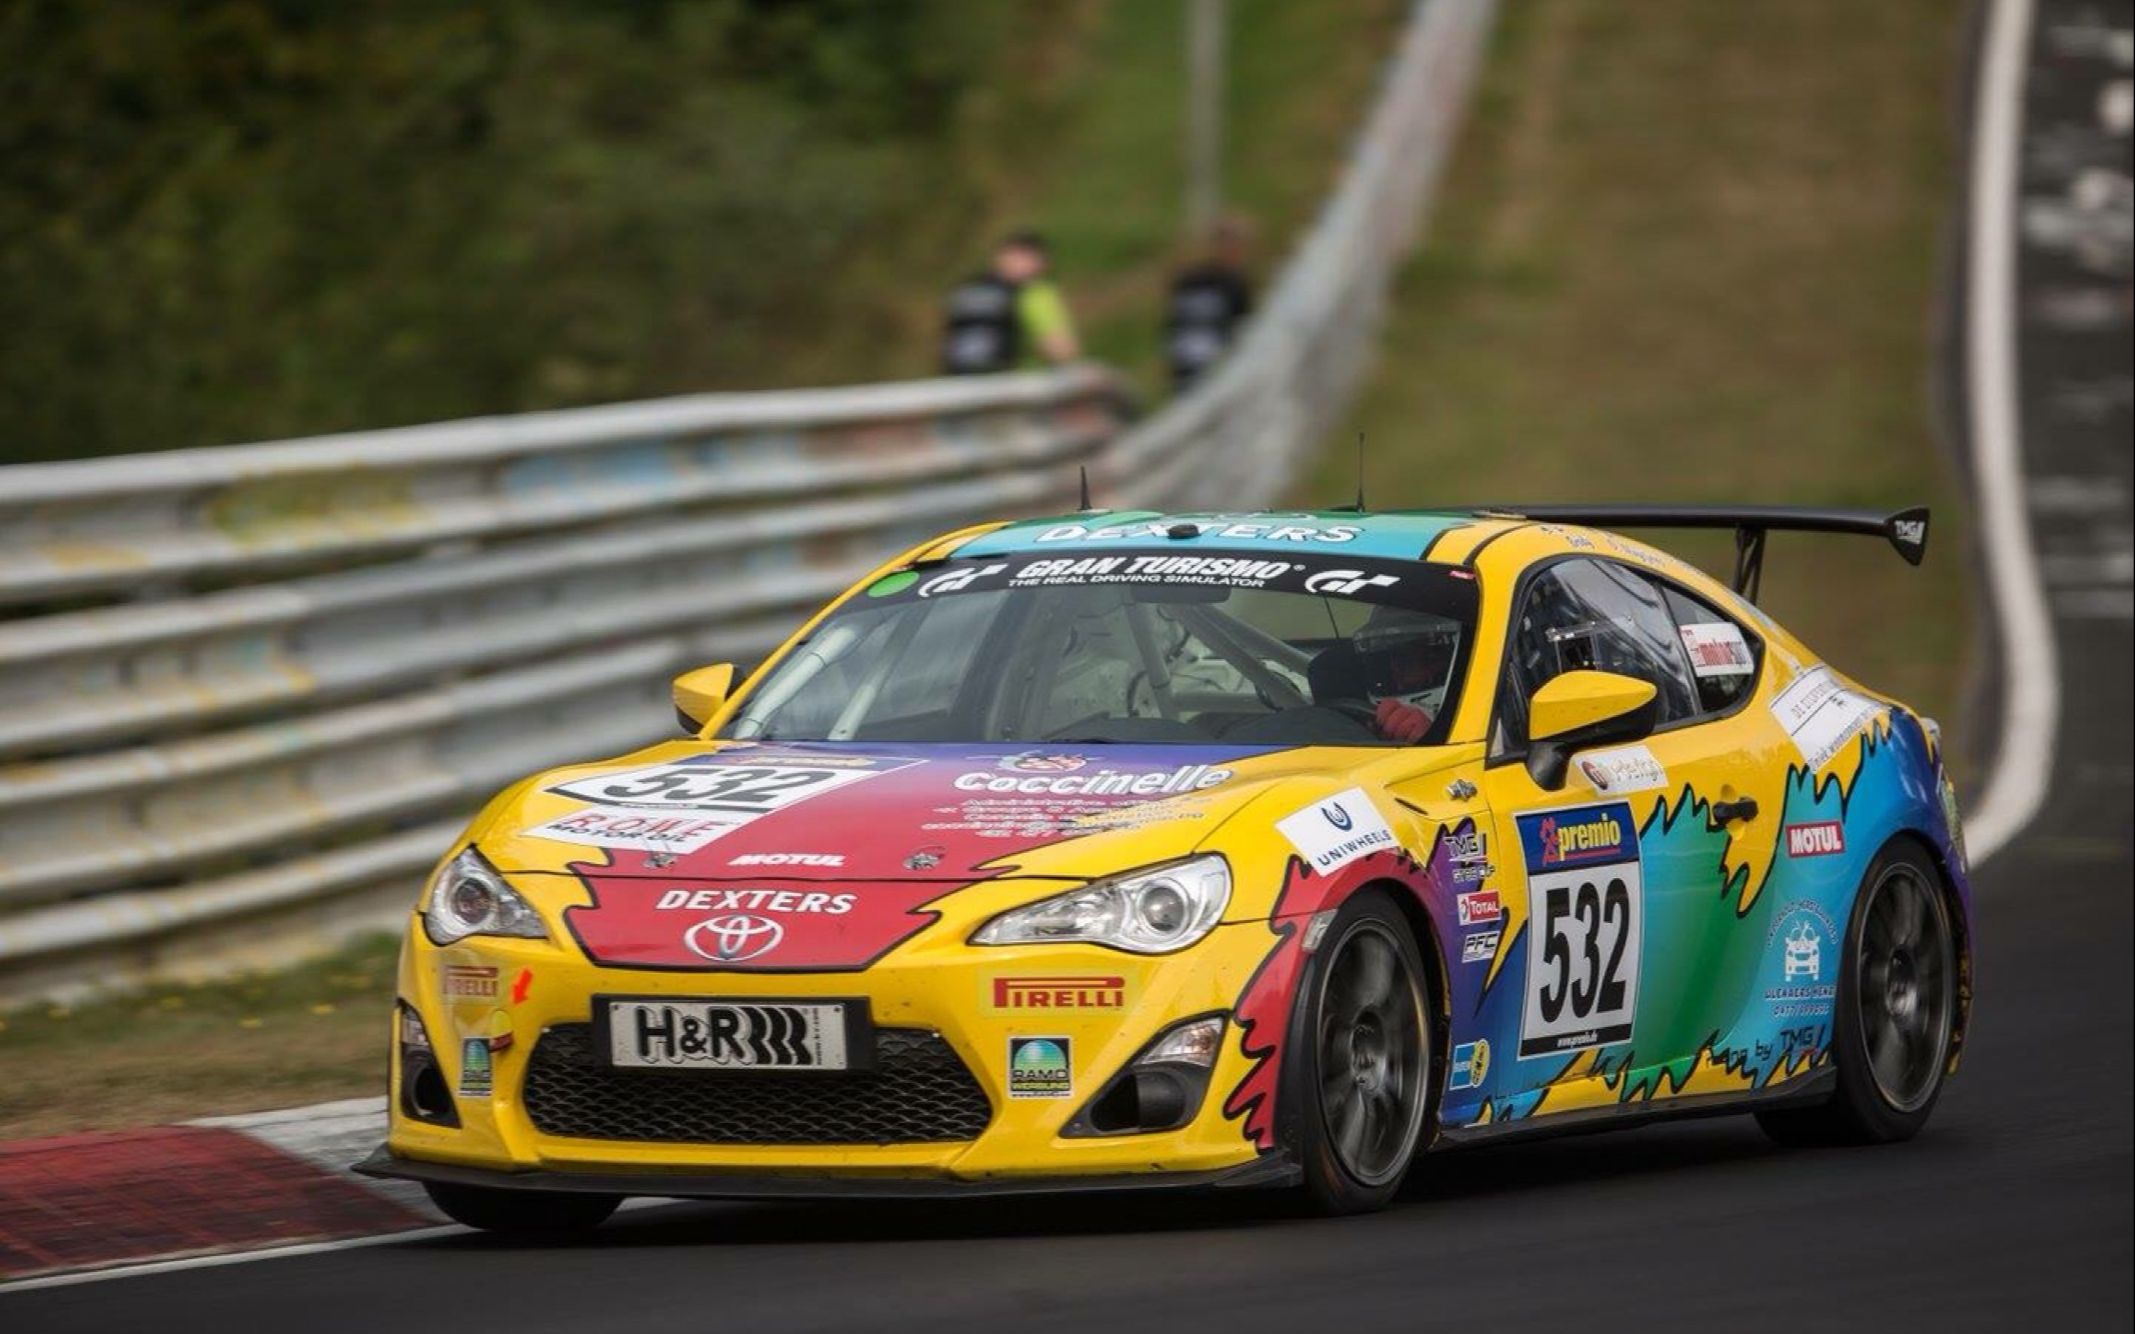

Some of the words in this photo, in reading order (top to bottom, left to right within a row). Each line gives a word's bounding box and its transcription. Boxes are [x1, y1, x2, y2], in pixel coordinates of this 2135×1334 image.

[1035, 523, 1364, 542] DEXTERS
[1016, 557, 1127, 578] GRAN
[1130, 557, 1291, 579] TURISMO
[1008, 578, 1040, 587] THE
[1043, 575, 1087, 585] REAL
[1090, 574, 1161, 584] DRIVING
[1164, 575, 1265, 588] SIMULATOR
[602, 767, 837, 803] 532
[953, 765, 1234, 794] Coccinelle
[545, 823, 647, 841] MOTOR
[647, 831, 687, 843] OIL
[557, 812, 729, 836] ROWE
[1316, 829, 1393, 866] UNIWHEELS
[1558, 812, 1622, 862] premio
[1789, 825, 1842, 854] MOTUL
[727, 853, 847, 867] MOTUL
[655, 890, 858, 914] DEXTERS
[1469, 893, 1499, 915] TOTAL
[1464, 932, 1498, 952] PFC
[1539, 876, 1631, 1024] 532
[443, 965, 499, 997] PIRELLI
[993, 976, 1126, 1008] PIRELLI
[1755, 1037, 1773, 1060] by
[1011, 1069, 1069, 1081] RAMO
